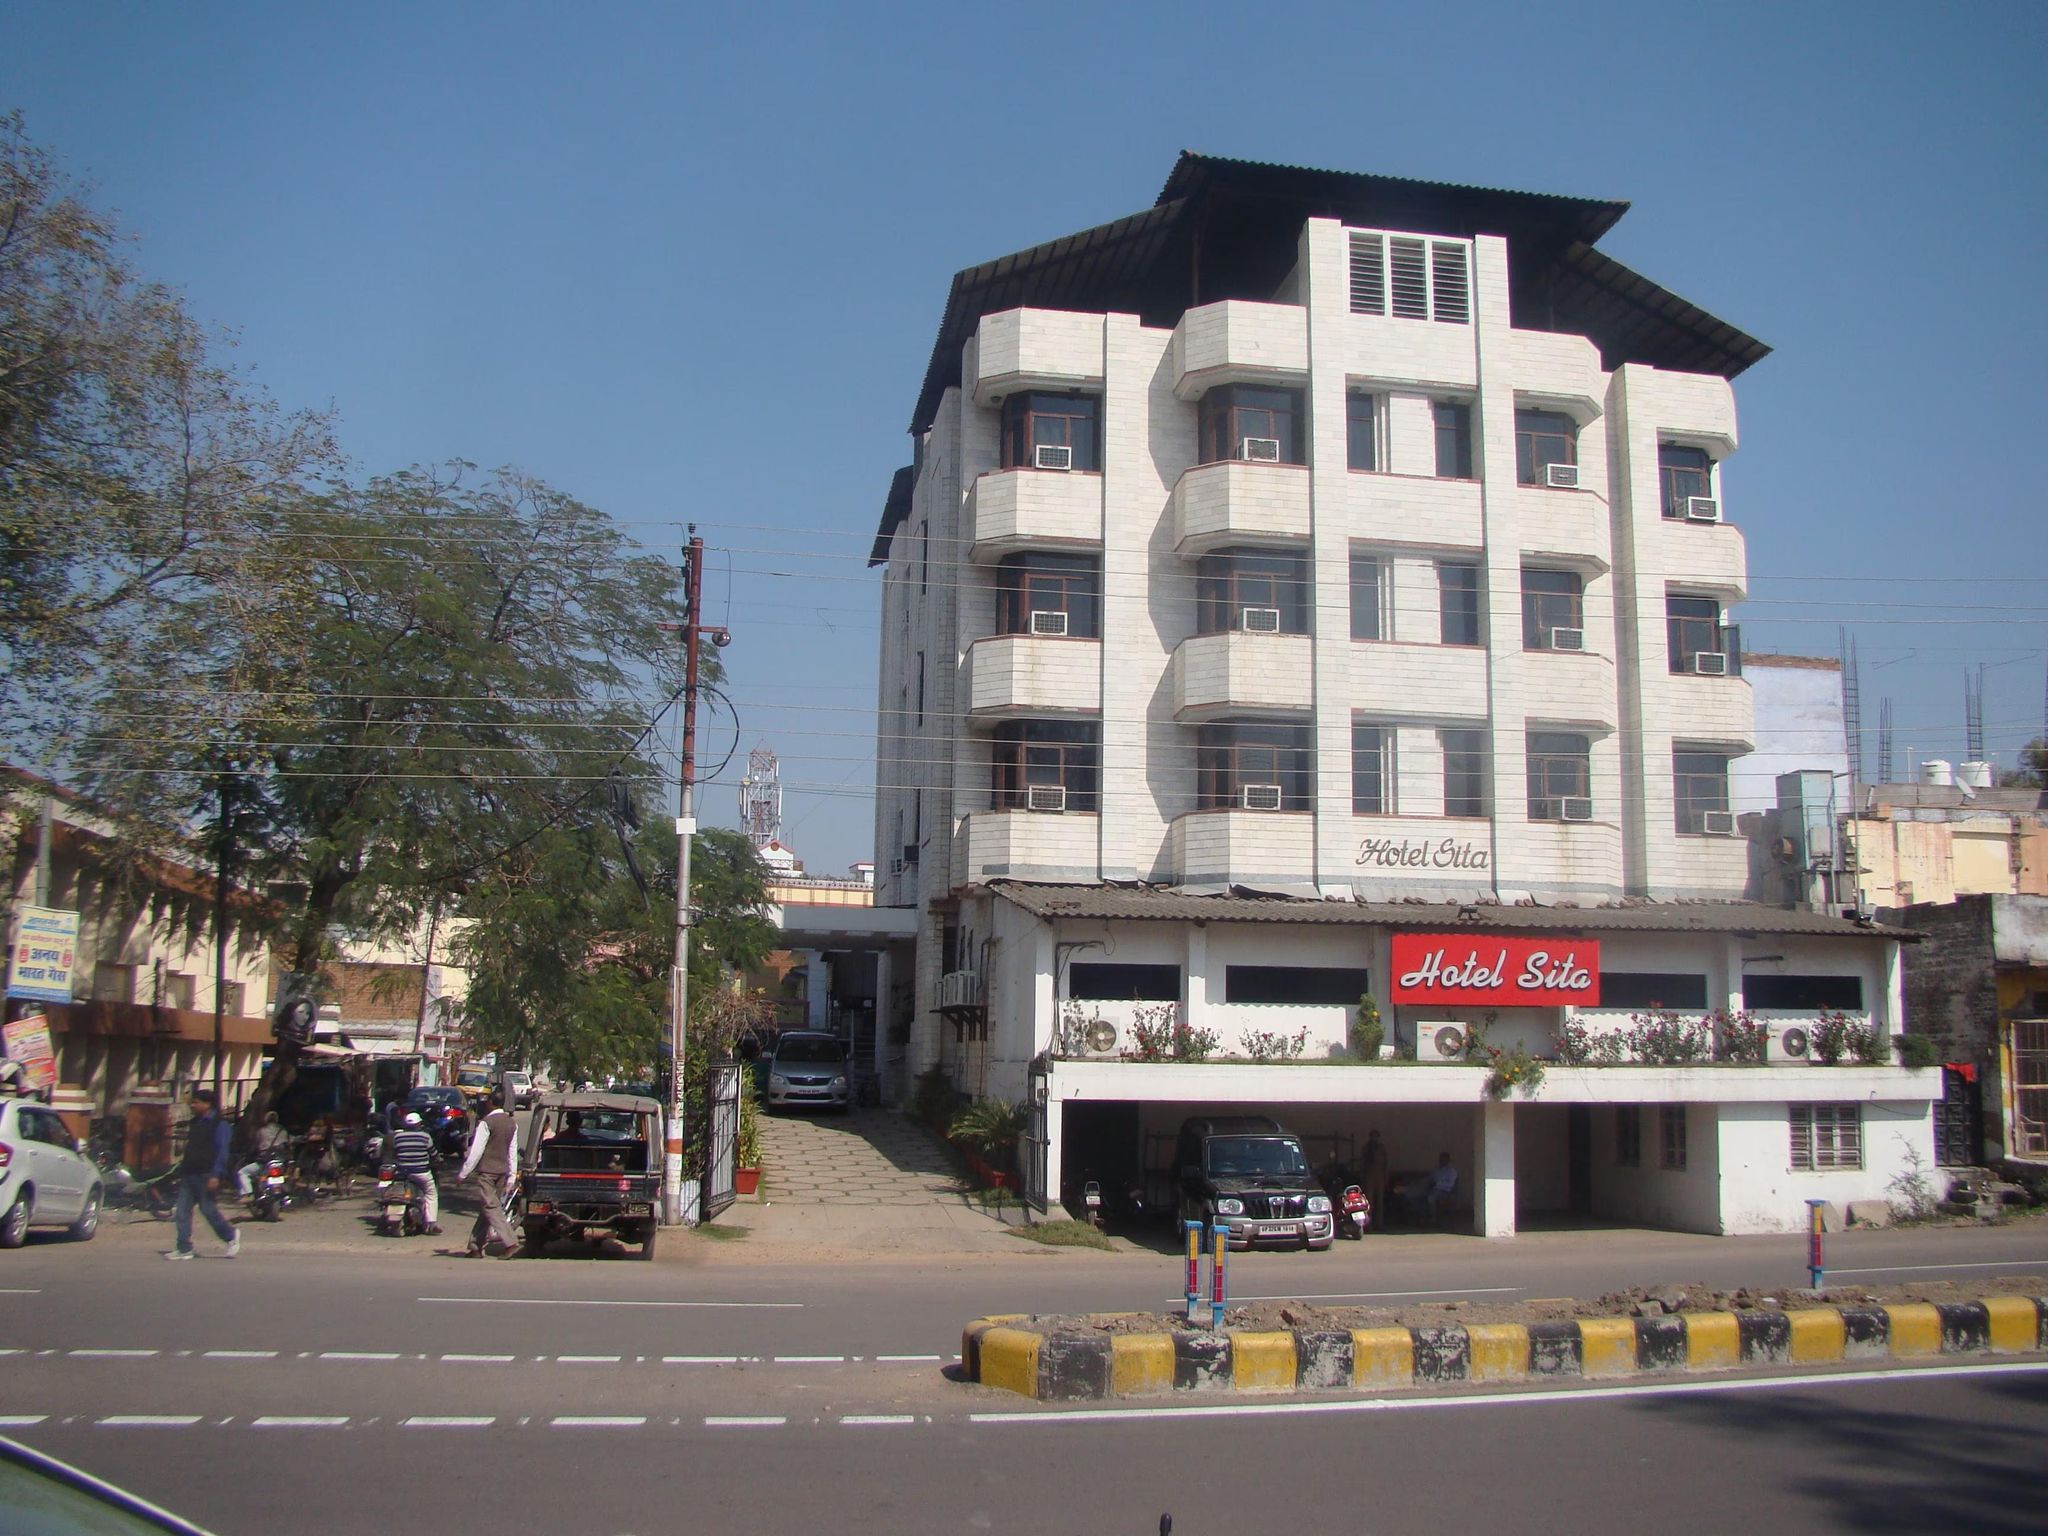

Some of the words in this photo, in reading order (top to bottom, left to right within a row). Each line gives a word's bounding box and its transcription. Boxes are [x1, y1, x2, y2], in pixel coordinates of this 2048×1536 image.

[1355, 838, 1429, 867] Hotel
[1433, 838, 1488, 869] Sita
[1399, 948, 1507, 988] Hotel
[1517, 951, 1592, 990] Sita
